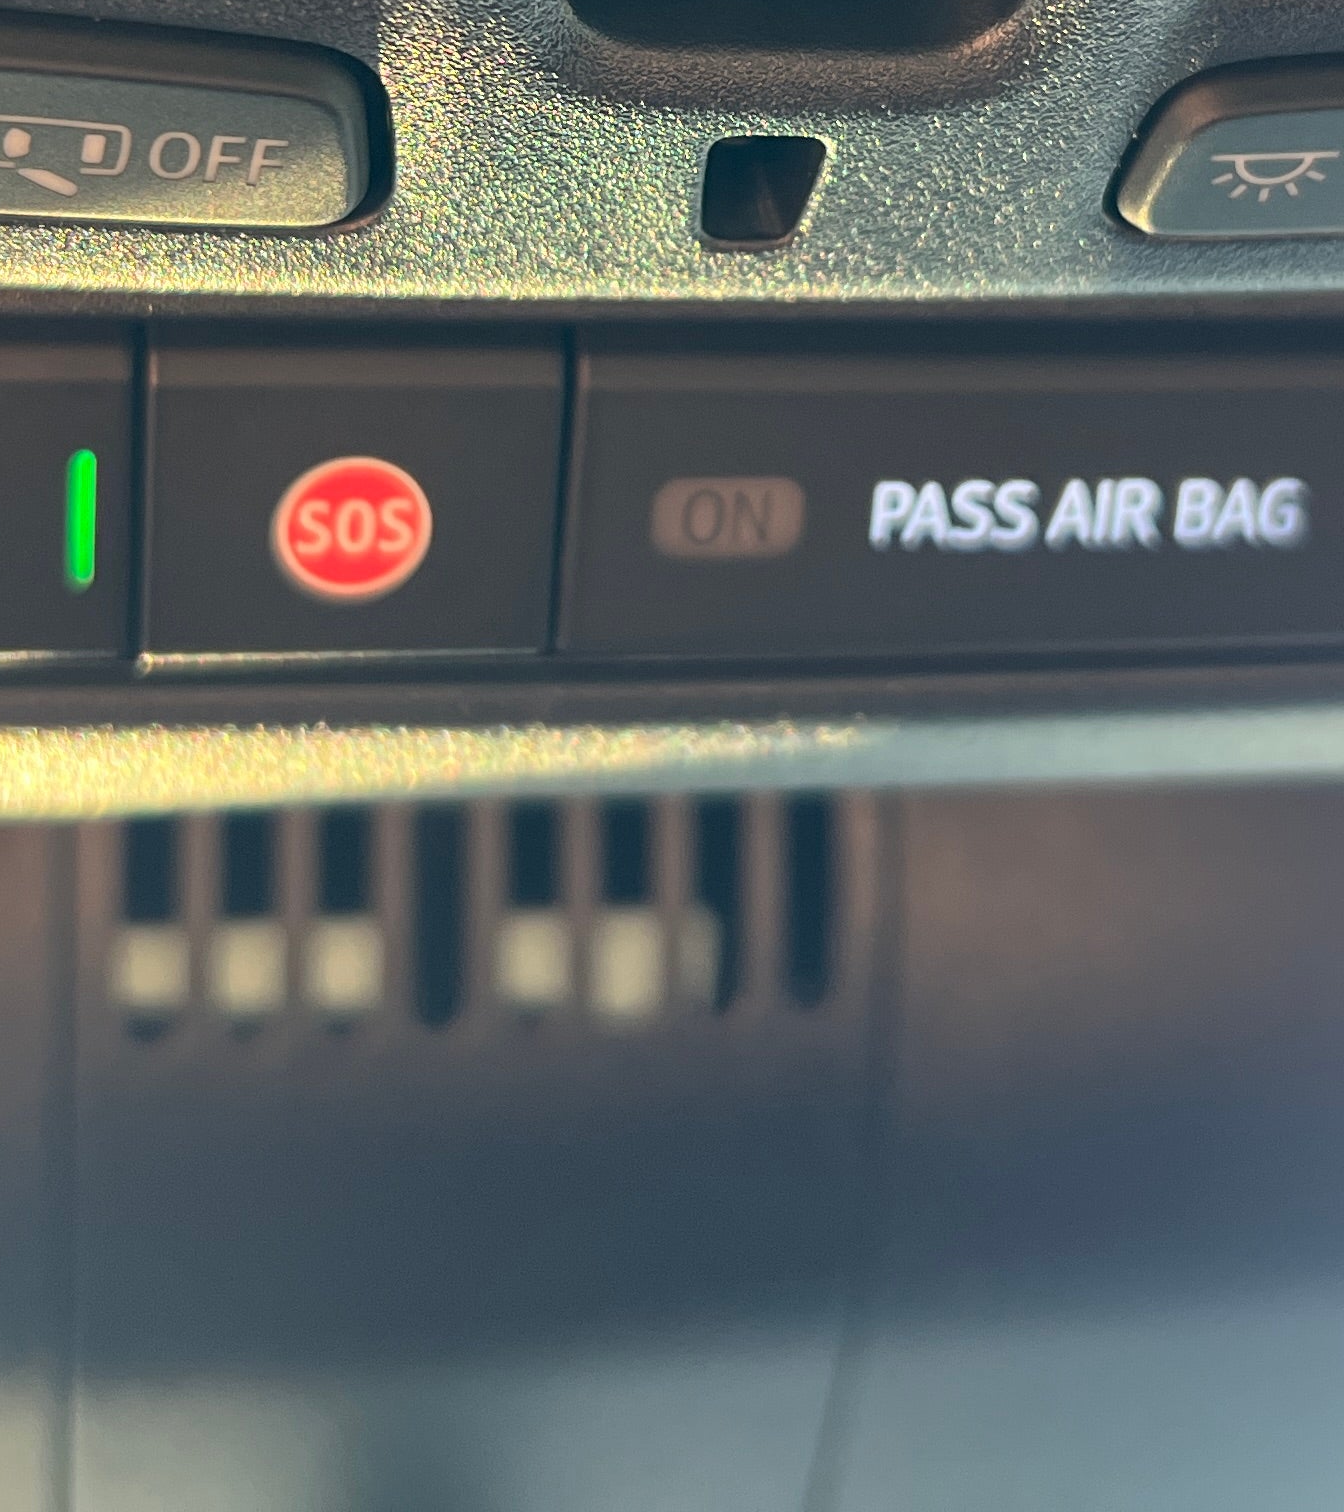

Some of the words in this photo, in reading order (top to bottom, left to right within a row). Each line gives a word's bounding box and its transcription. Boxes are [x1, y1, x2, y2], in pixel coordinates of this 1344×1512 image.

[148, 131, 289, 186] OFF
[295, 497, 415, 555] SOS
[681, 489, 773, 546] ON
[869, 478, 1040, 553] PASS
[1045, 477, 1164, 552] AIR
[1173, 476, 1309, 549] BAG
